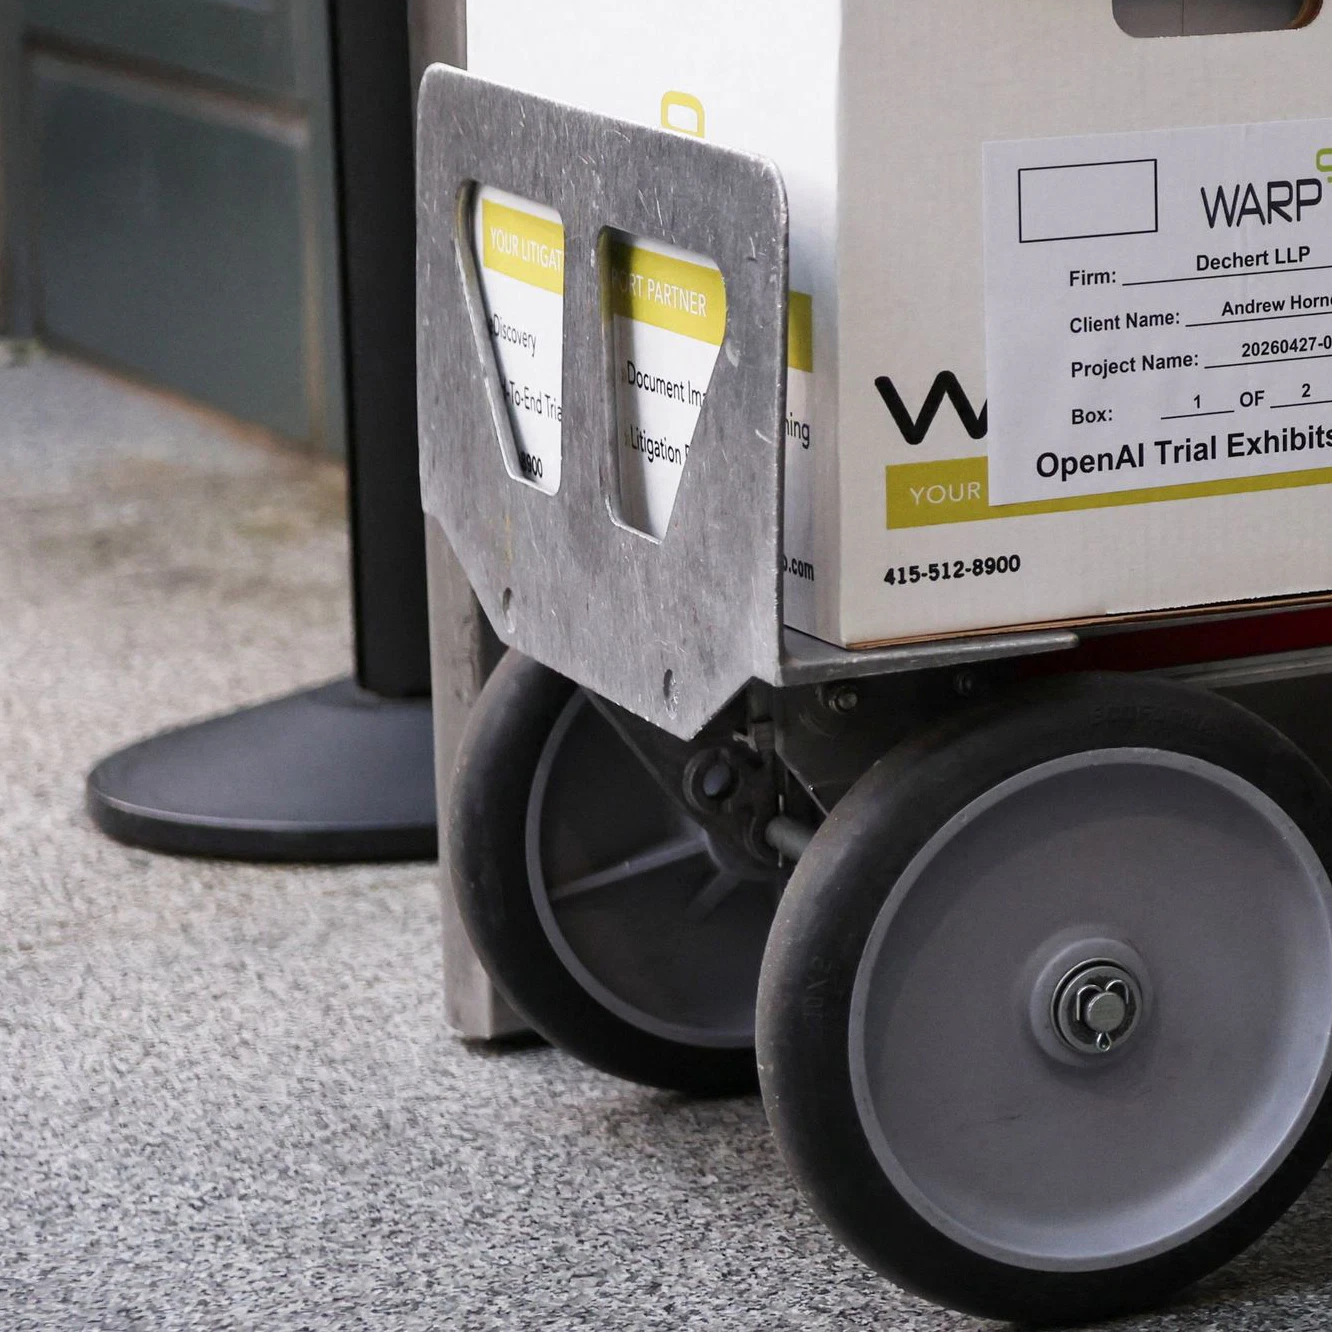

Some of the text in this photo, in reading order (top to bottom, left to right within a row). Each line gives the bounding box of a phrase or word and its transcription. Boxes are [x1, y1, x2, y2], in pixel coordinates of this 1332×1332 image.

[490, 228, 518, 256] YOUR
[1070, 246, 1310, 287] Firm: Dechert LLP
[647, 278, 706, 317] PARTNER
[1070, 315, 1120, 333] Client
[1126, 312, 1179, 329] Name:
[1221, 299, 1285, 316] Andrew
[627, 360, 685, 402] Document
[1071, 357, 1136, 379] Project
[1142, 354, 1198, 371] Name:
[1072, 409, 1112, 425] Box:
[1240, 390, 1265, 407] OF
[1302, 383, 1311, 398] 2
[631, 424, 681, 465] Litigation
[1036, 443, 1144, 482] OpenAI
[1154, 435, 1216, 465] Trial
[910, 481, 981, 505] YOUR
[884, 554, 1021, 586] 415-512-8900
